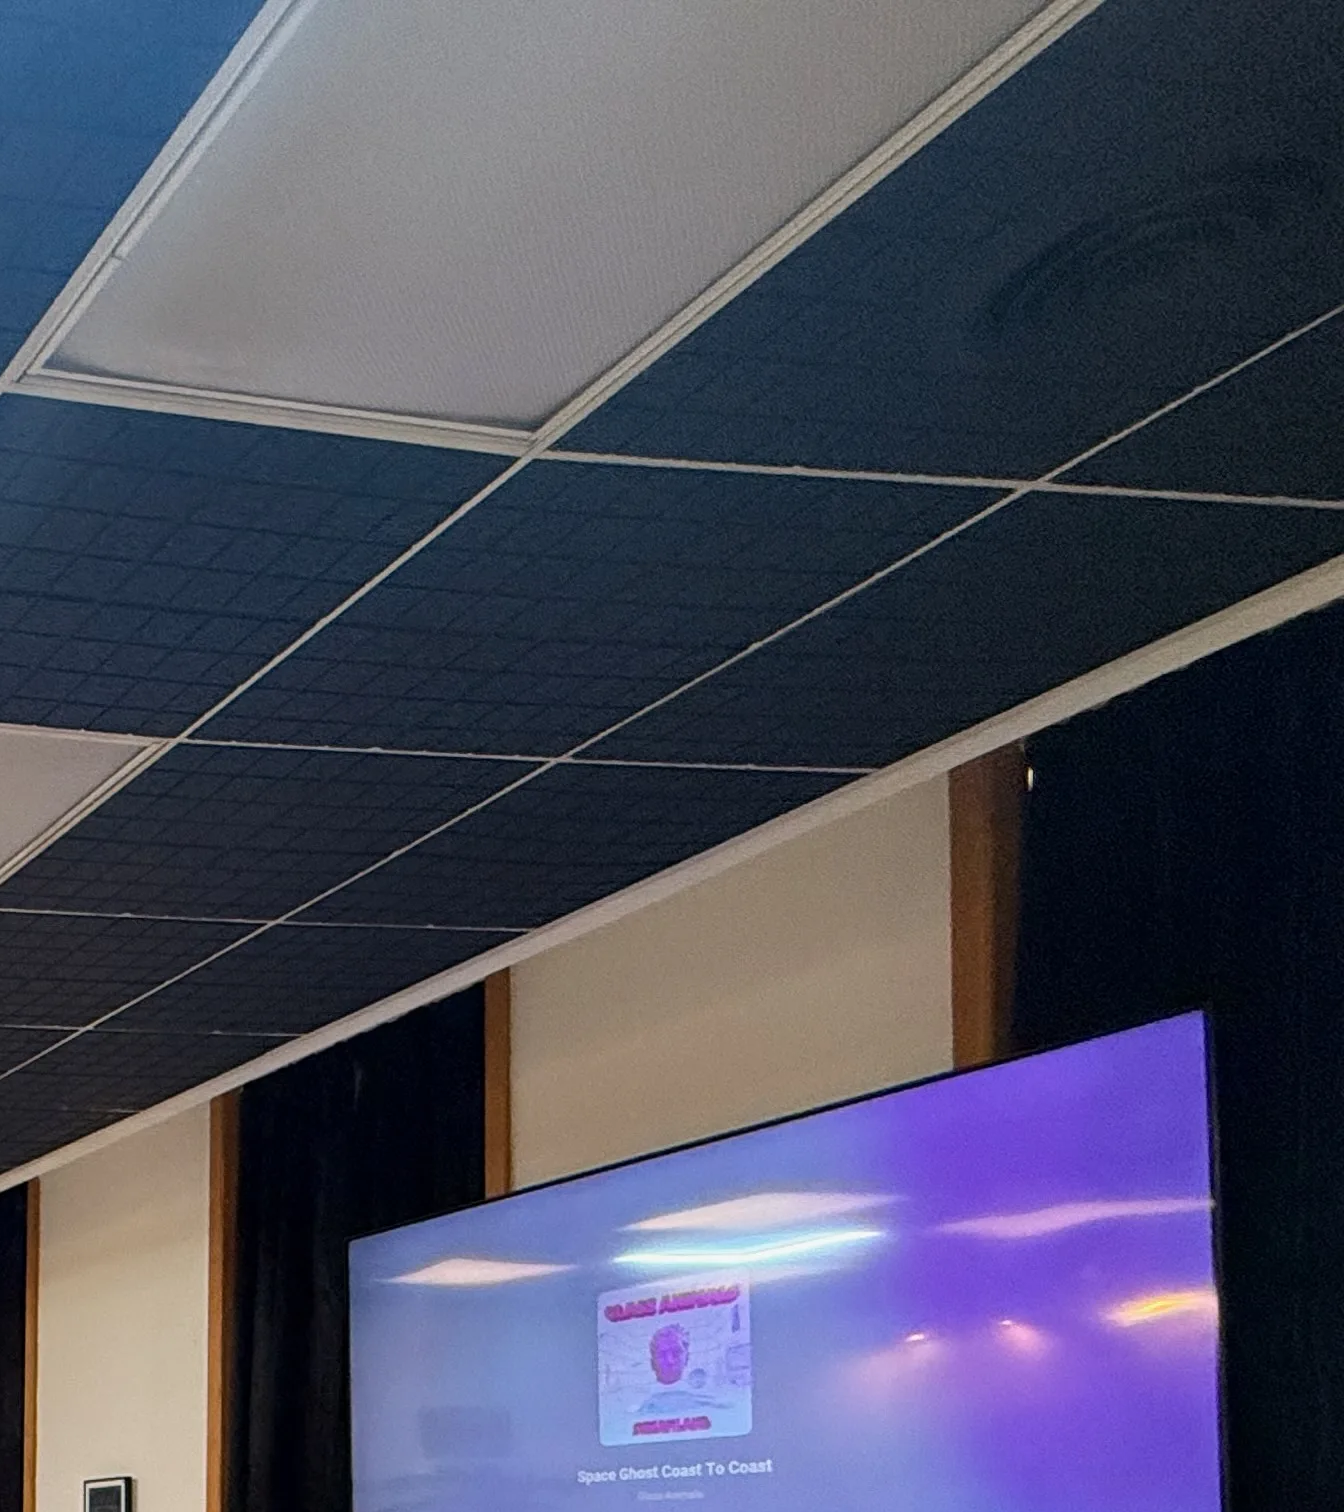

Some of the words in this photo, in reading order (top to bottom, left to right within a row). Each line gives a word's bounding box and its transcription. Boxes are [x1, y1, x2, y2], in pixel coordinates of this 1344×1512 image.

[577, 1471, 616, 1486] Space
[618, 1467, 659, 1481] Ghost
[661, 1463, 702, 1478] Coast
[706, 1462, 725, 1475] To
[728, 1459, 773, 1474] Coast
